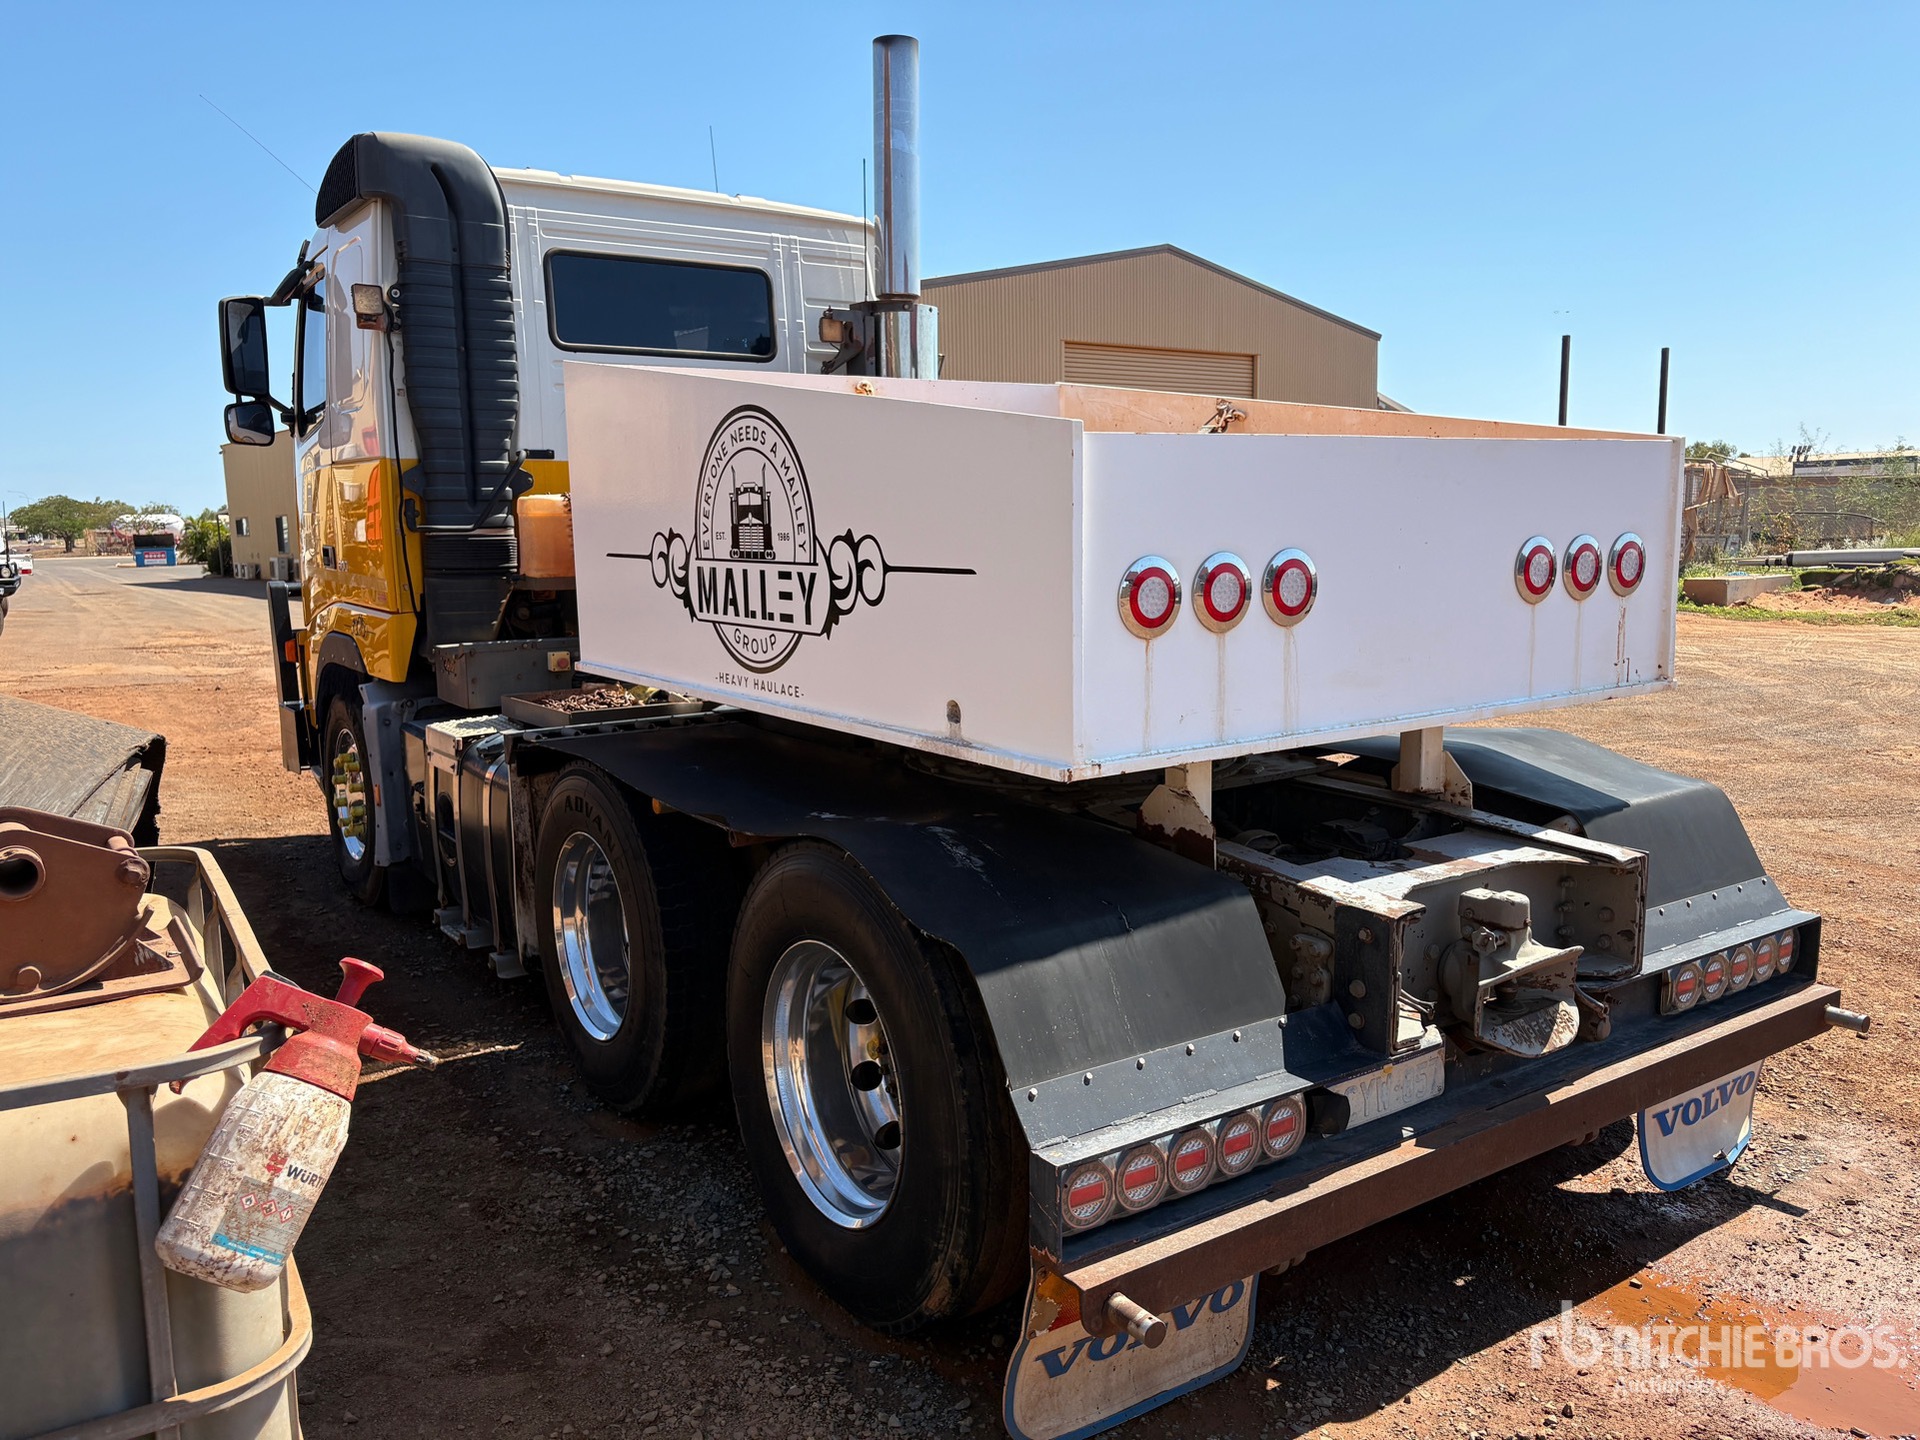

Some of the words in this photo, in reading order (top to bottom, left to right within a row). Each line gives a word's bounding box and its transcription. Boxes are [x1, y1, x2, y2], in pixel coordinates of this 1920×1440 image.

[702, 441, 728, 550] EVERYONE
[730, 425, 767, 447] NEEDS
[769, 441, 778, 458] A
[780, 456, 807, 553] MALLEY
[696, 565, 817, 626] MALLEY
[733, 627, 777, 655] GROUP
[1651, 1070, 1756, 1137] VOLVO
[1034, 1279, 1245, 1379] VOVO
